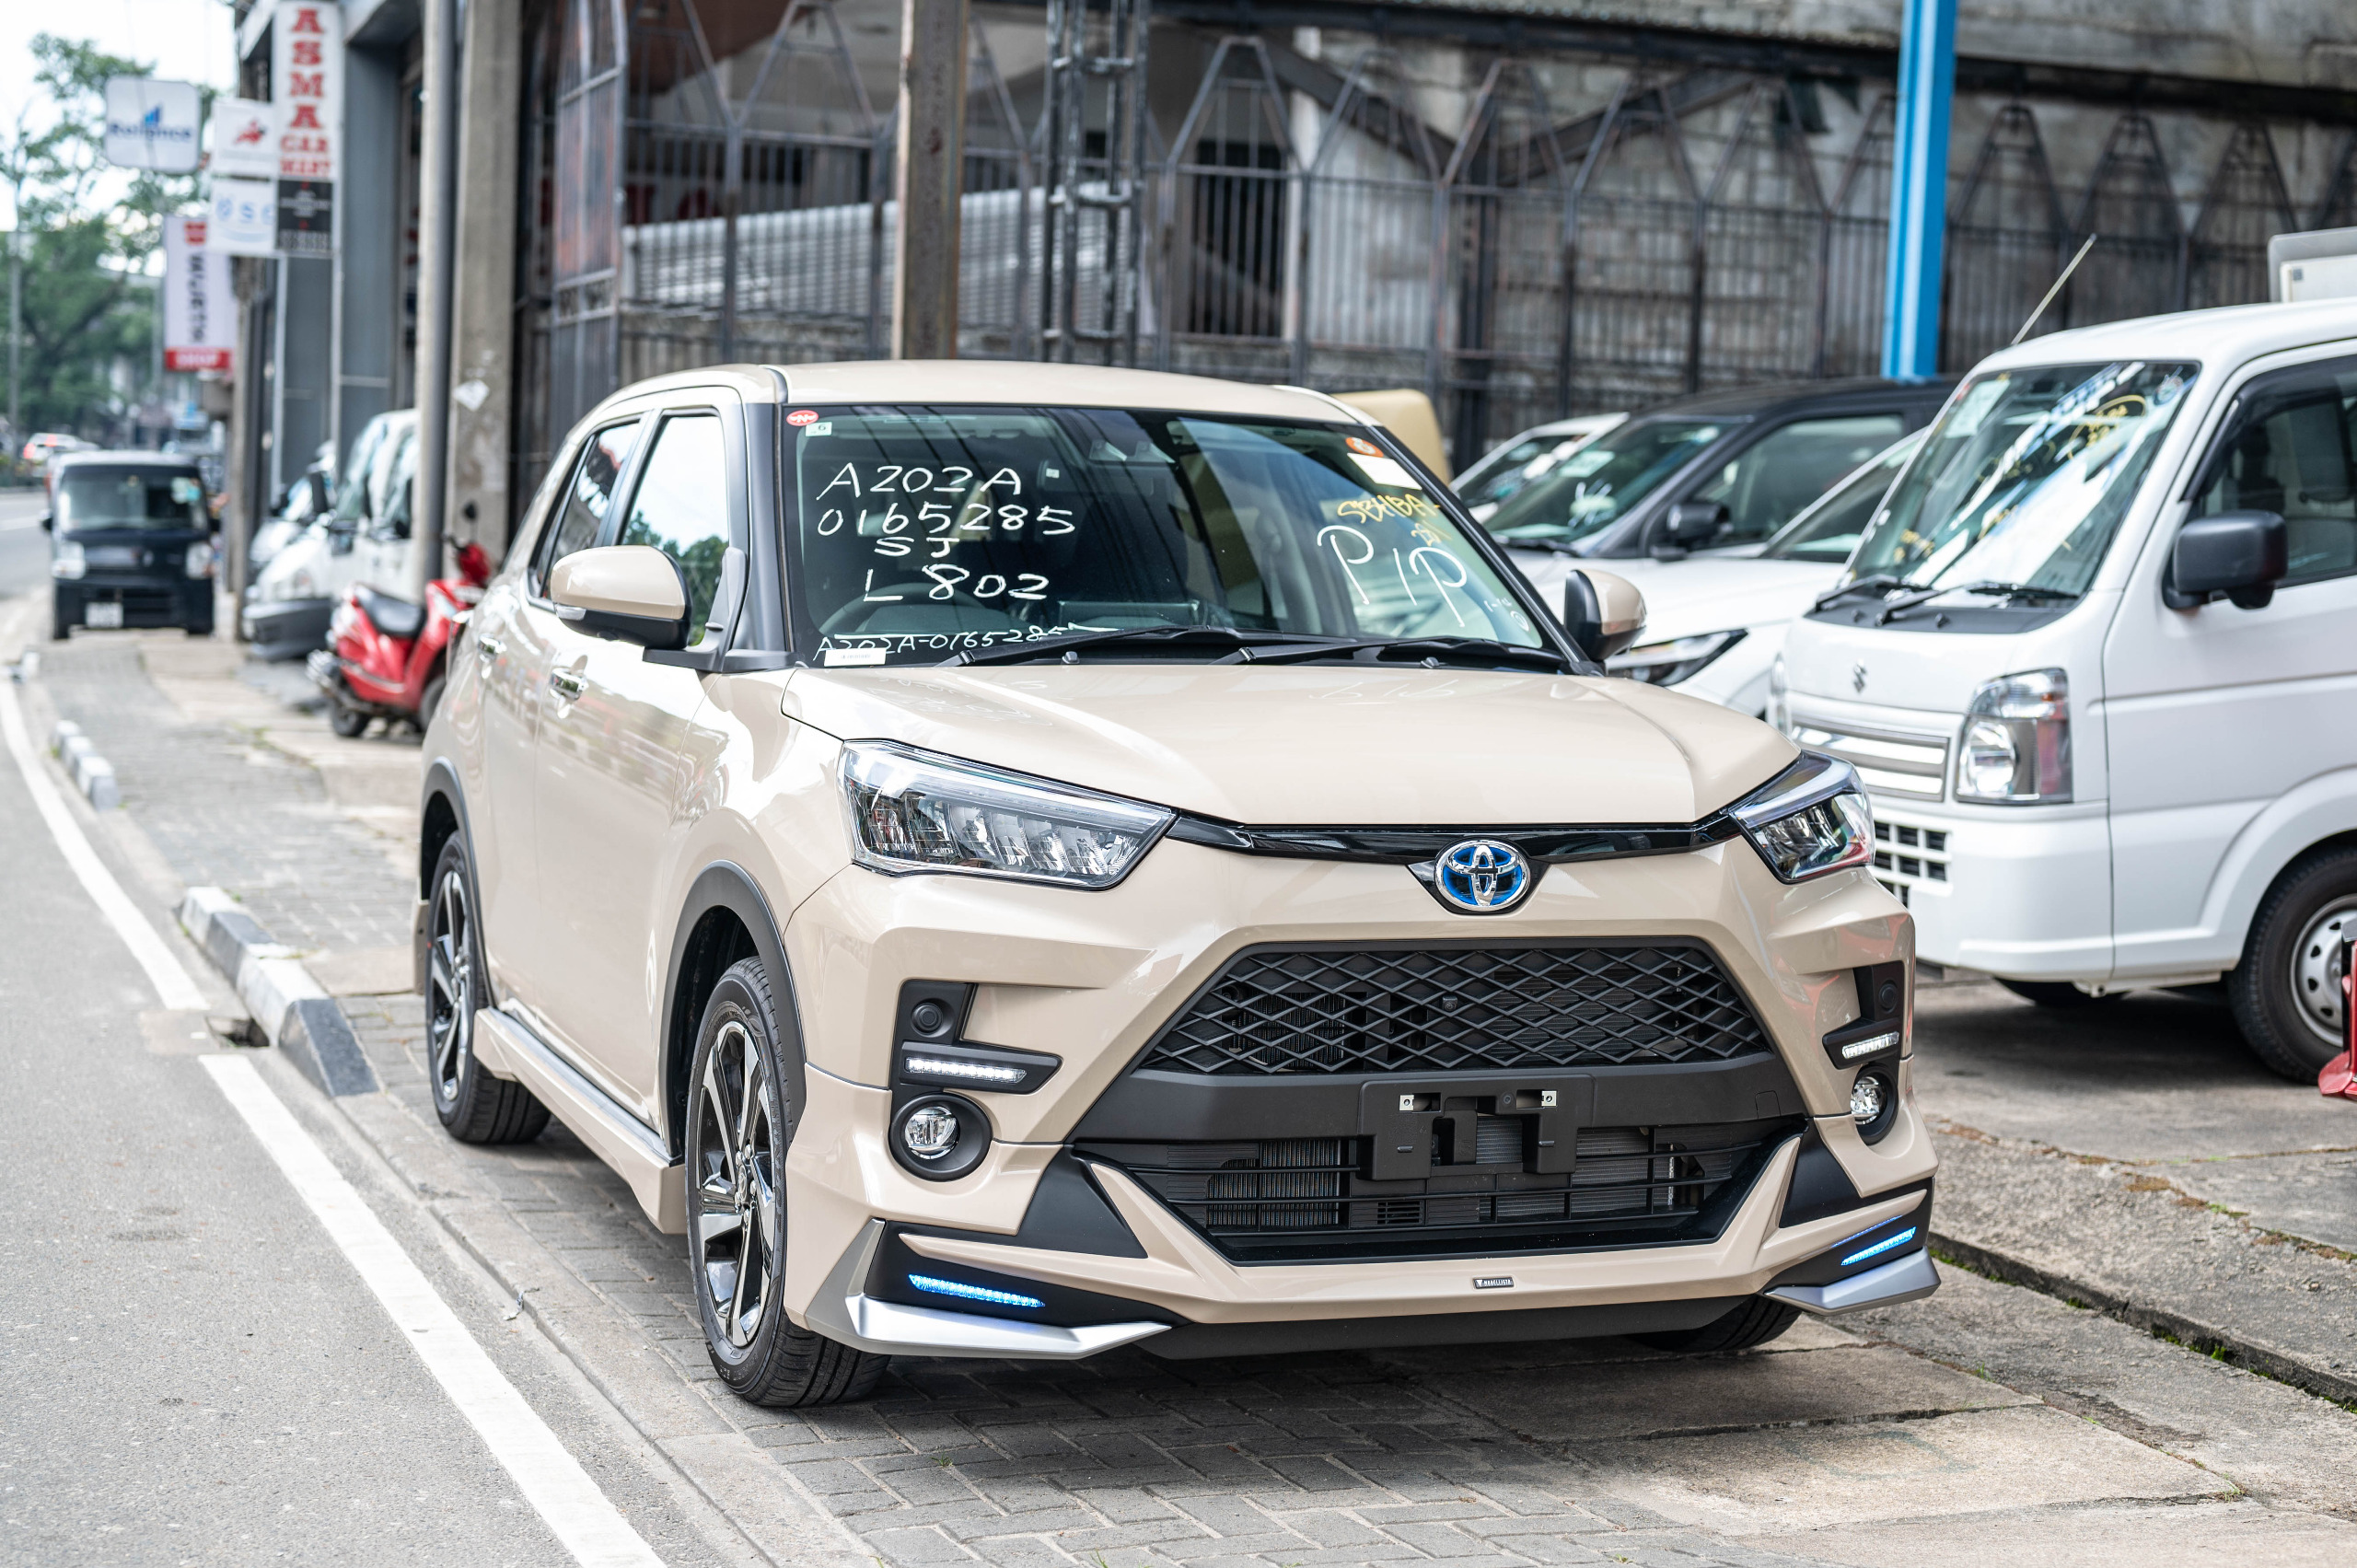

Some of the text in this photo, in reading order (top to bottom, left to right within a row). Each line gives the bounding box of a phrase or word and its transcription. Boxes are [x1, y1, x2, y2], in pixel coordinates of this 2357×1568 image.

[290, 7, 325, 129] ASMA
[816, 462, 1021, 500] A202A
[817, 502, 1075, 536] 0165285
